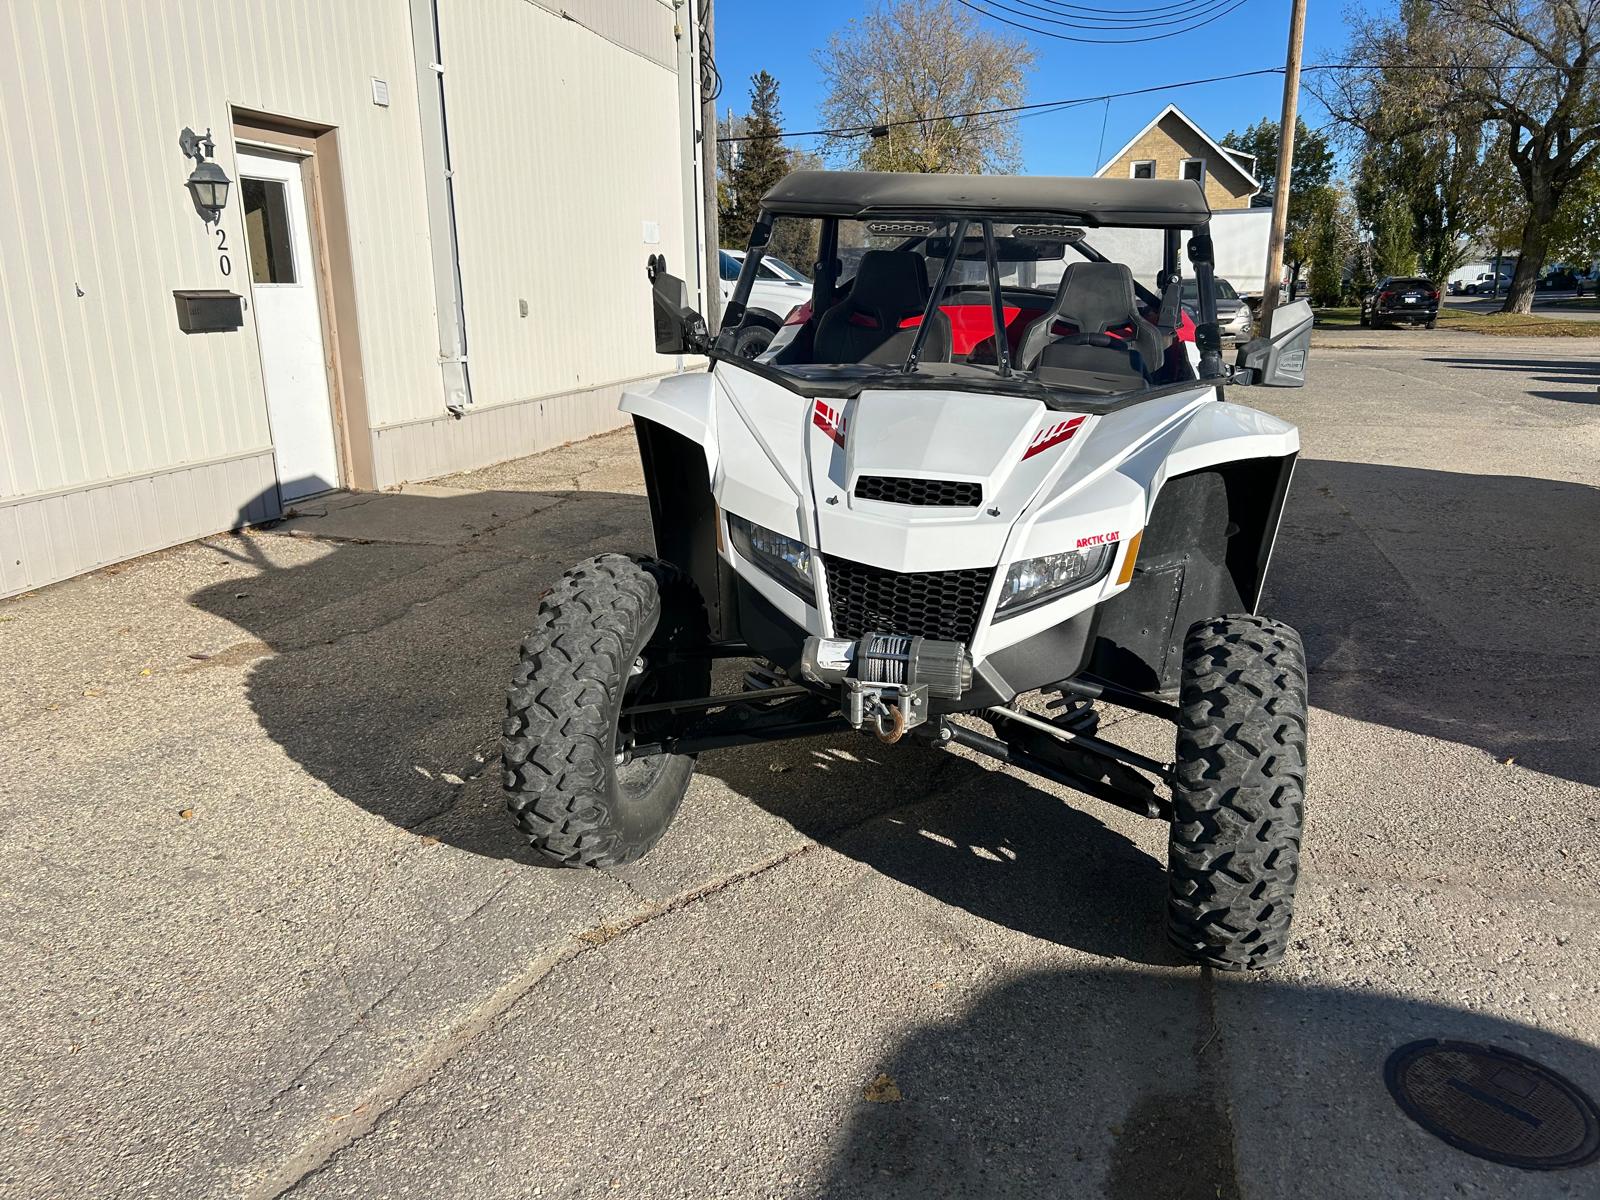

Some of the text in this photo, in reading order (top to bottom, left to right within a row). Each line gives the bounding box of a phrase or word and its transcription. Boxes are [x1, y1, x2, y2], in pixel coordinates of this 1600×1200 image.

[216, 229, 231, 276] 20
[1077, 531, 1119, 548] ARCTIC CAT
